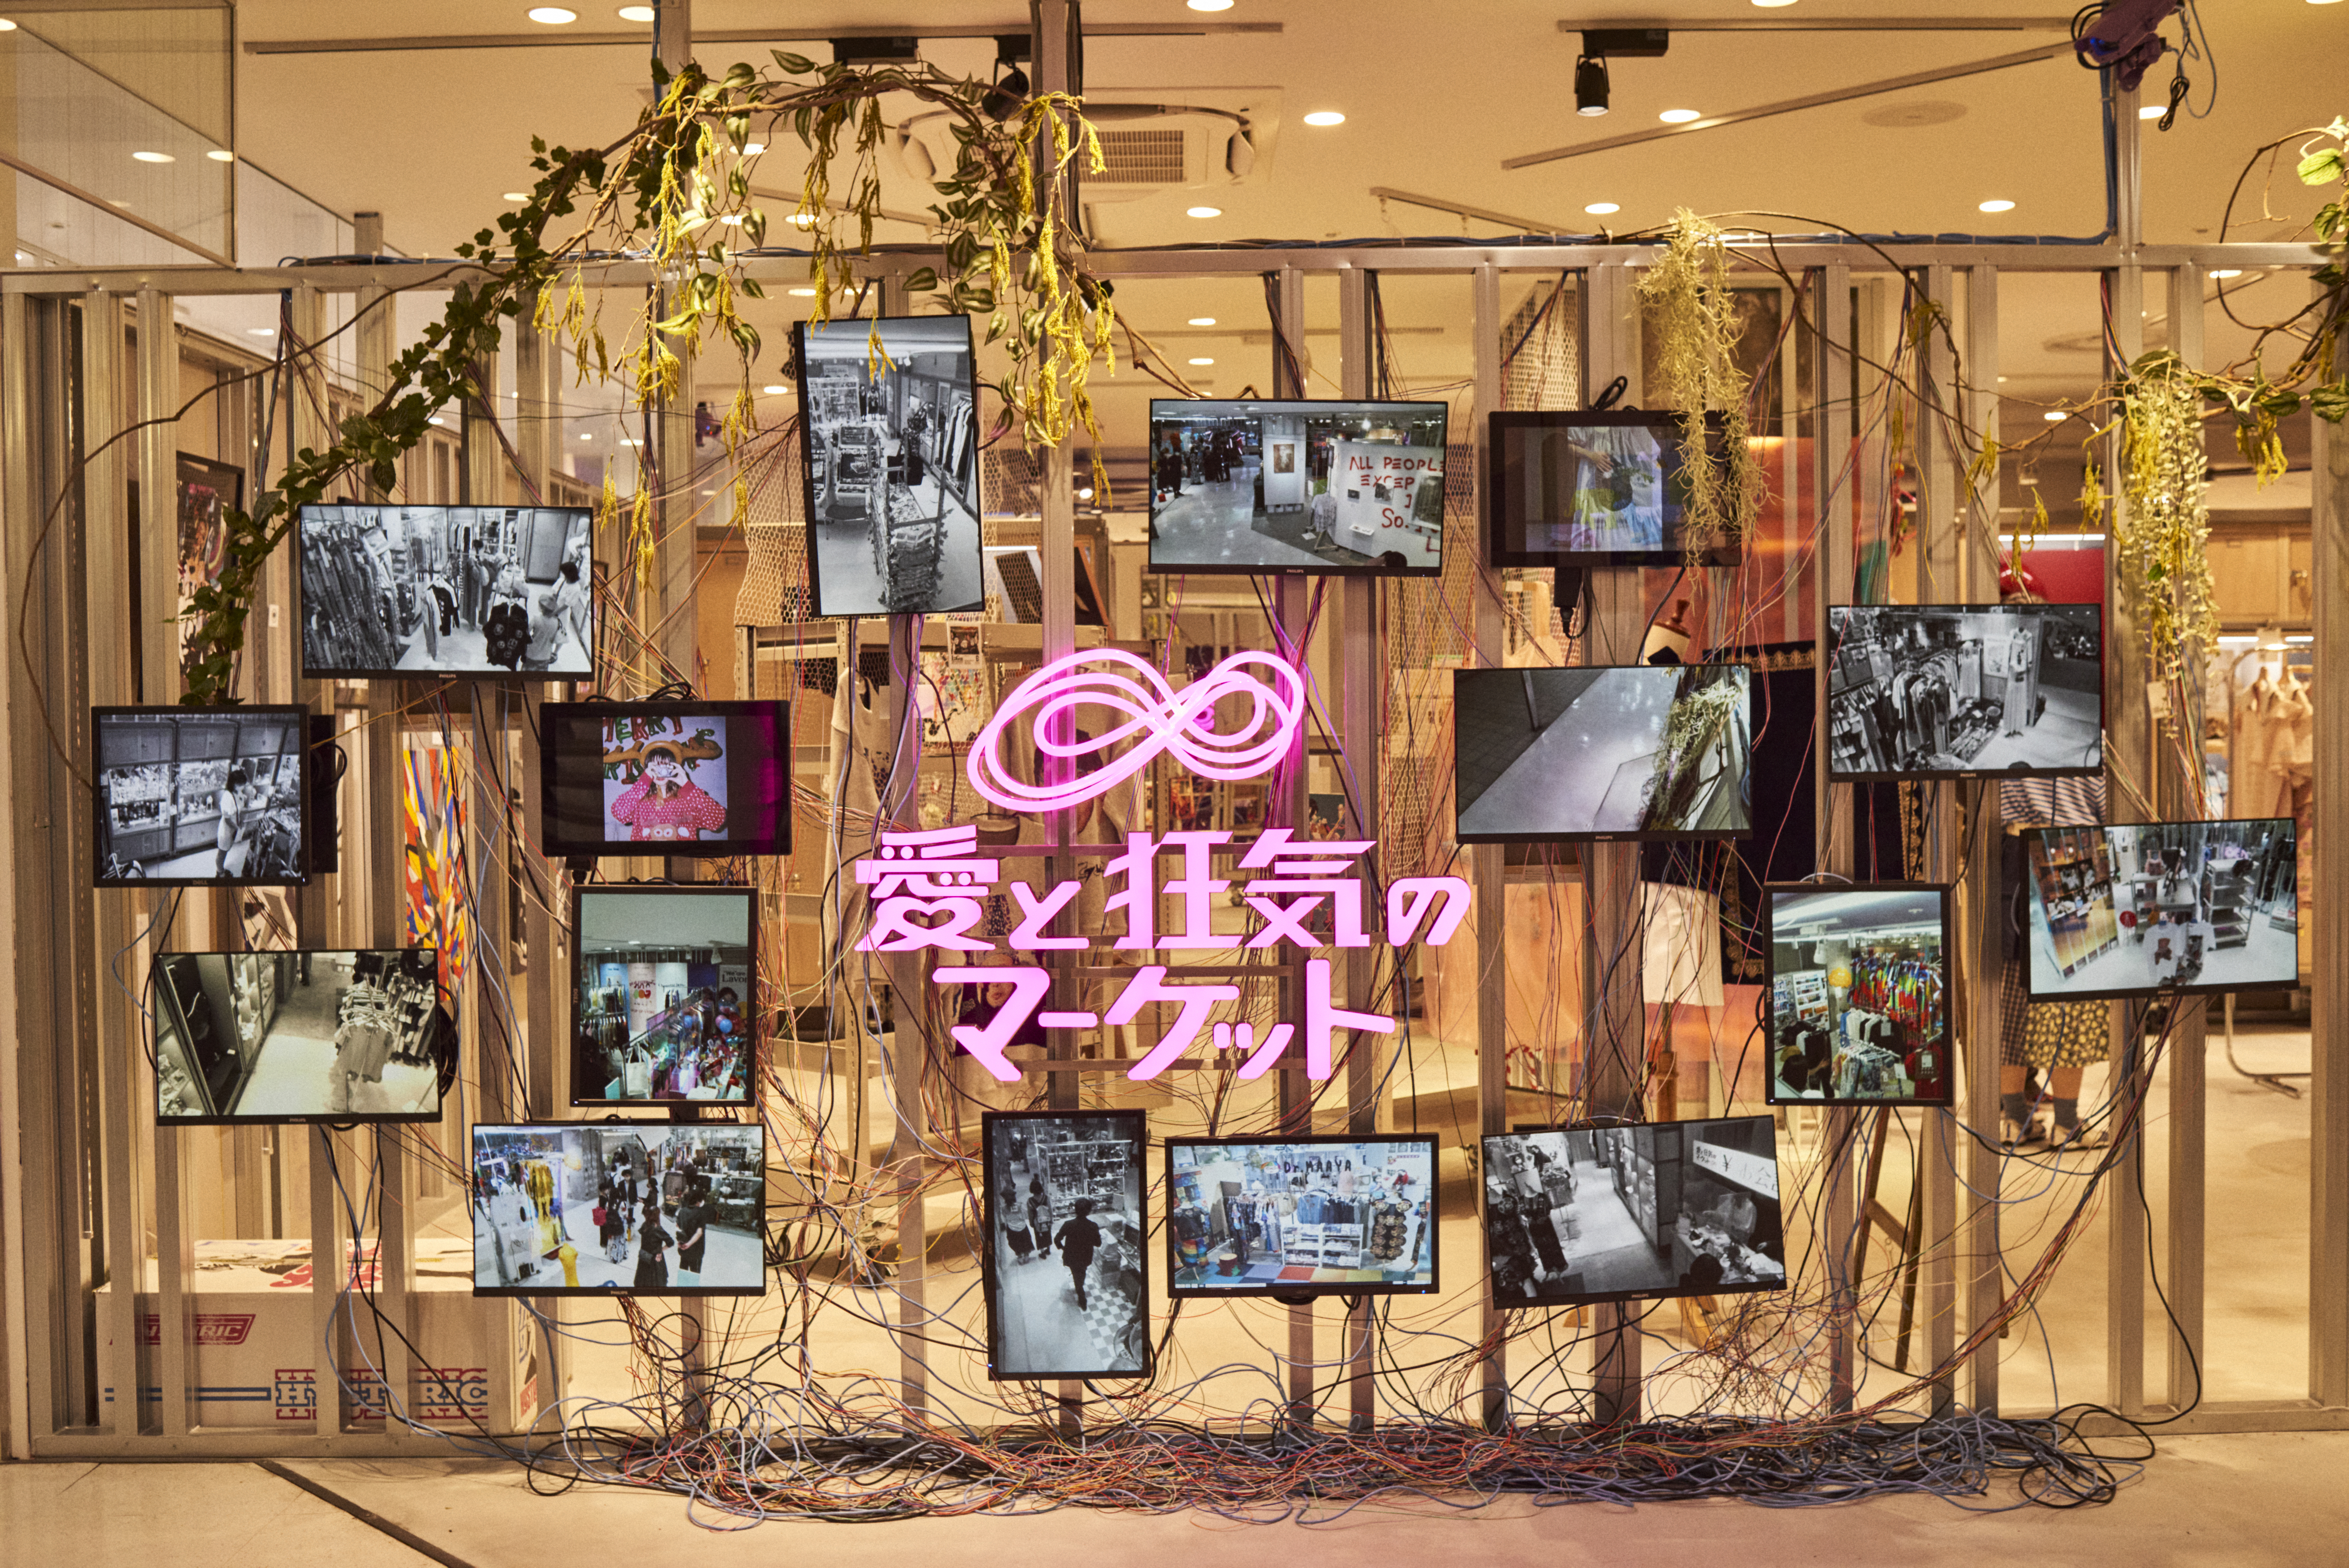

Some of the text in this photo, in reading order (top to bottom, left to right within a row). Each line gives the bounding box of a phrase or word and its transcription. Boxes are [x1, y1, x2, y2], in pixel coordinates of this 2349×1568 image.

[1350, 456, 1373, 470] ALL
[855, 824, 1471, 951] 愛と狂気の
[932, 959, 1395, 1082] マーケット
